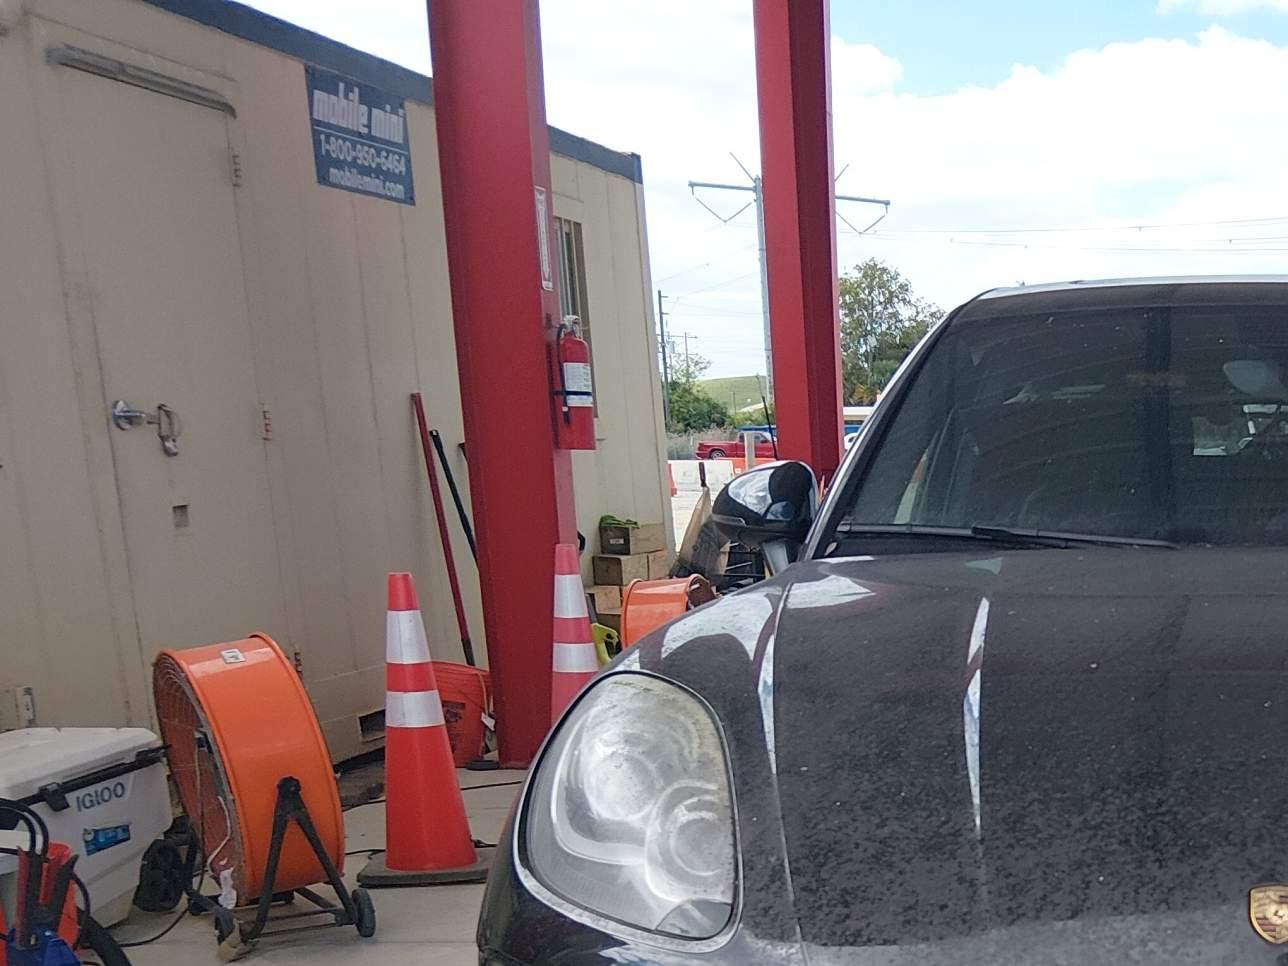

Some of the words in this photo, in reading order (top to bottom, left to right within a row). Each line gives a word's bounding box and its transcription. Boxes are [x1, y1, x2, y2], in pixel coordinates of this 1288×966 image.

[312, 82, 369, 134] mobile
[371, 104, 404, 144] mini
[320, 134, 406, 176] 1-800-950-6464
[328, 166, 405, 200] mobilemini.com
[76, 782, 126, 812] IGLOO
